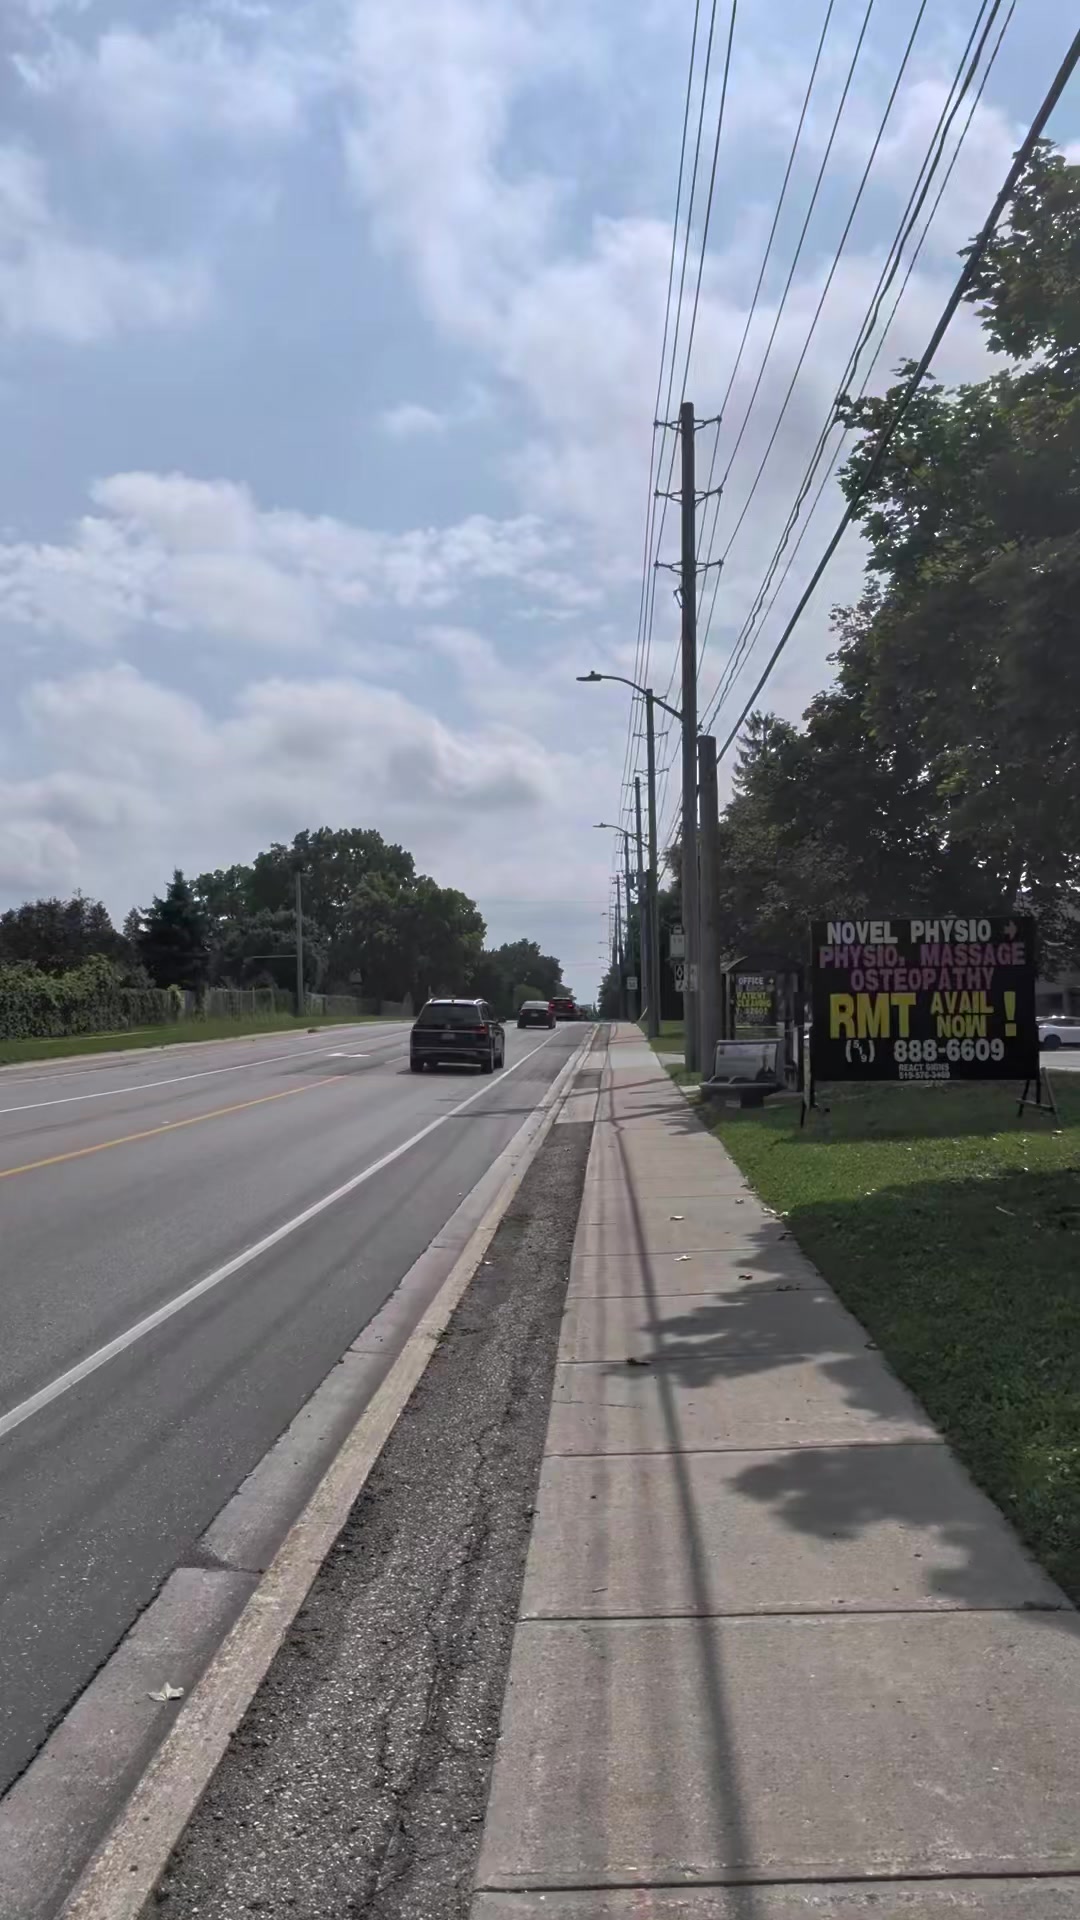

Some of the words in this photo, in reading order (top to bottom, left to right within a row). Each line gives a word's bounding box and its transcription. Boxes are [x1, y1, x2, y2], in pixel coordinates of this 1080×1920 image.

[827, 921, 898, 944] NOVEL
[910, 919, 992, 943] PHYSIO
[920, 942, 1025, 965] MASSAGE
[739, 977, 764, 985] OFFICE
[851, 968, 994, 991] OSTEOPATHY
[830, 993, 916, 1039] RMT
[930, 991, 994, 1014] AVAIL
[937, 1015, 986, 1037] NOW
[894, 1039, 1004, 1062] 888-6609
